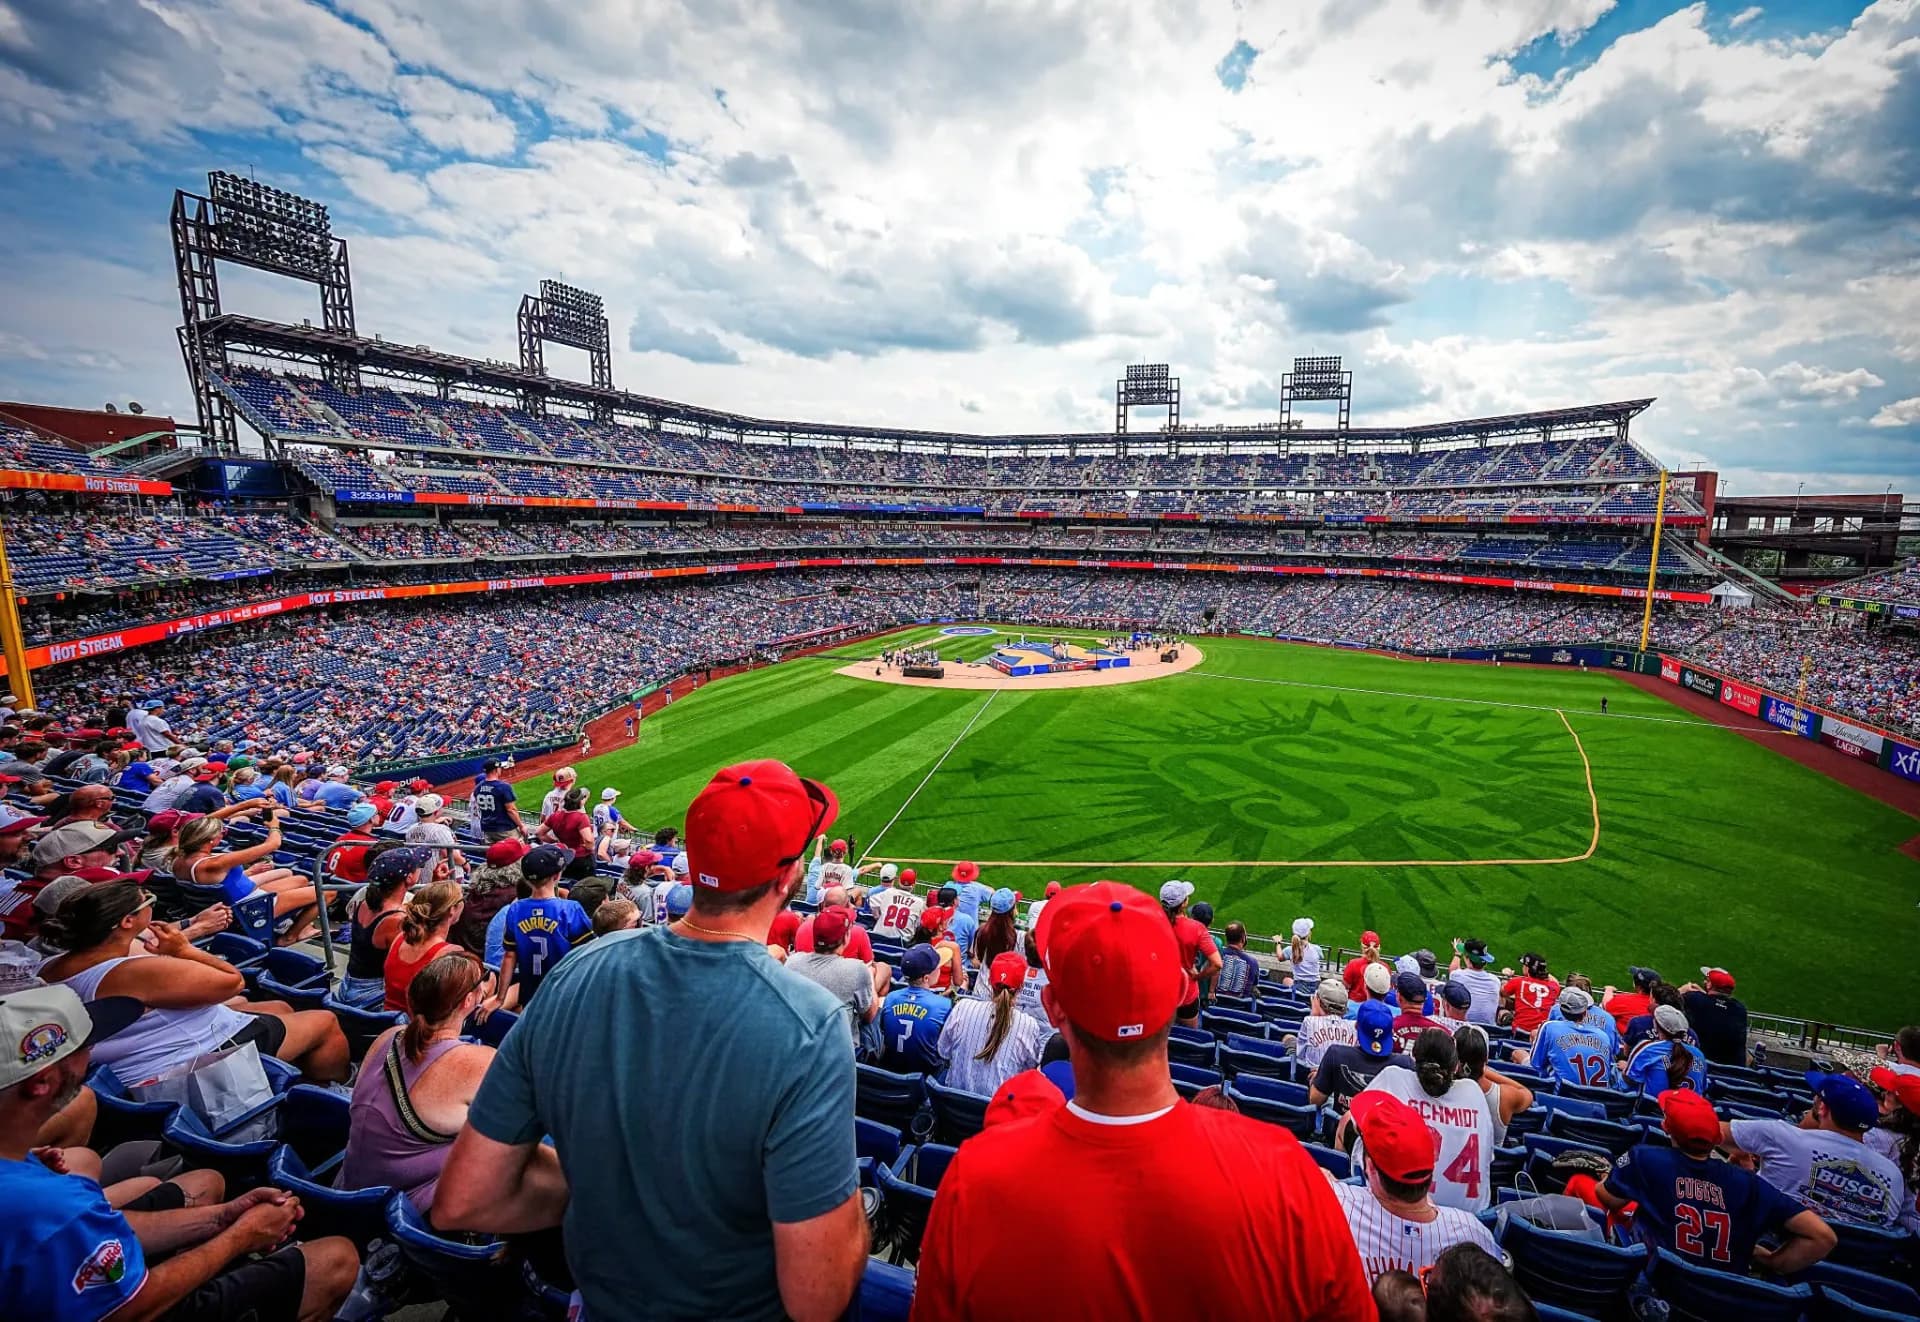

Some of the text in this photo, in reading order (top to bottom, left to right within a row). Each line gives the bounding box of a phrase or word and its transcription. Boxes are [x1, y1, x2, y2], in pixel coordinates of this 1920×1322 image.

[85, 478, 140, 492] HOT STREAK
[388, 493, 402, 501] PM
[468, 494, 525, 506] HOT STREAK
[611, 570, 653, 580] HOT STREAK
[488, 579, 545, 590] HOT STREAK
[1621, 588, 1636, 597] HOT
[308, 590, 385, 605] HOT STREAK
[50, 635, 123, 662] HOT STREAK
[1832, 722, 1870, 745] Yuengling
[1836, 739, 1861, 756] LAGER
[476, 794, 495, 811] 99
[330, 852, 341, 870] 6
[893, 896, 915, 906] UTLEY
[518, 917, 558, 934] TURNER
[530, 936, 548, 975] 7
[892, 1004, 928, 1020] TURNER
[897, 1019, 914, 1053] 7
[1310, 1027, 1360, 1048] CORCORA
[1569, 1053, 1608, 1088] 12
[1408, 1100, 1479, 1129] SCHMIDT
[1817, 1169, 1885, 1201] BUSCH
[1675, 1203, 1731, 1262] 27
